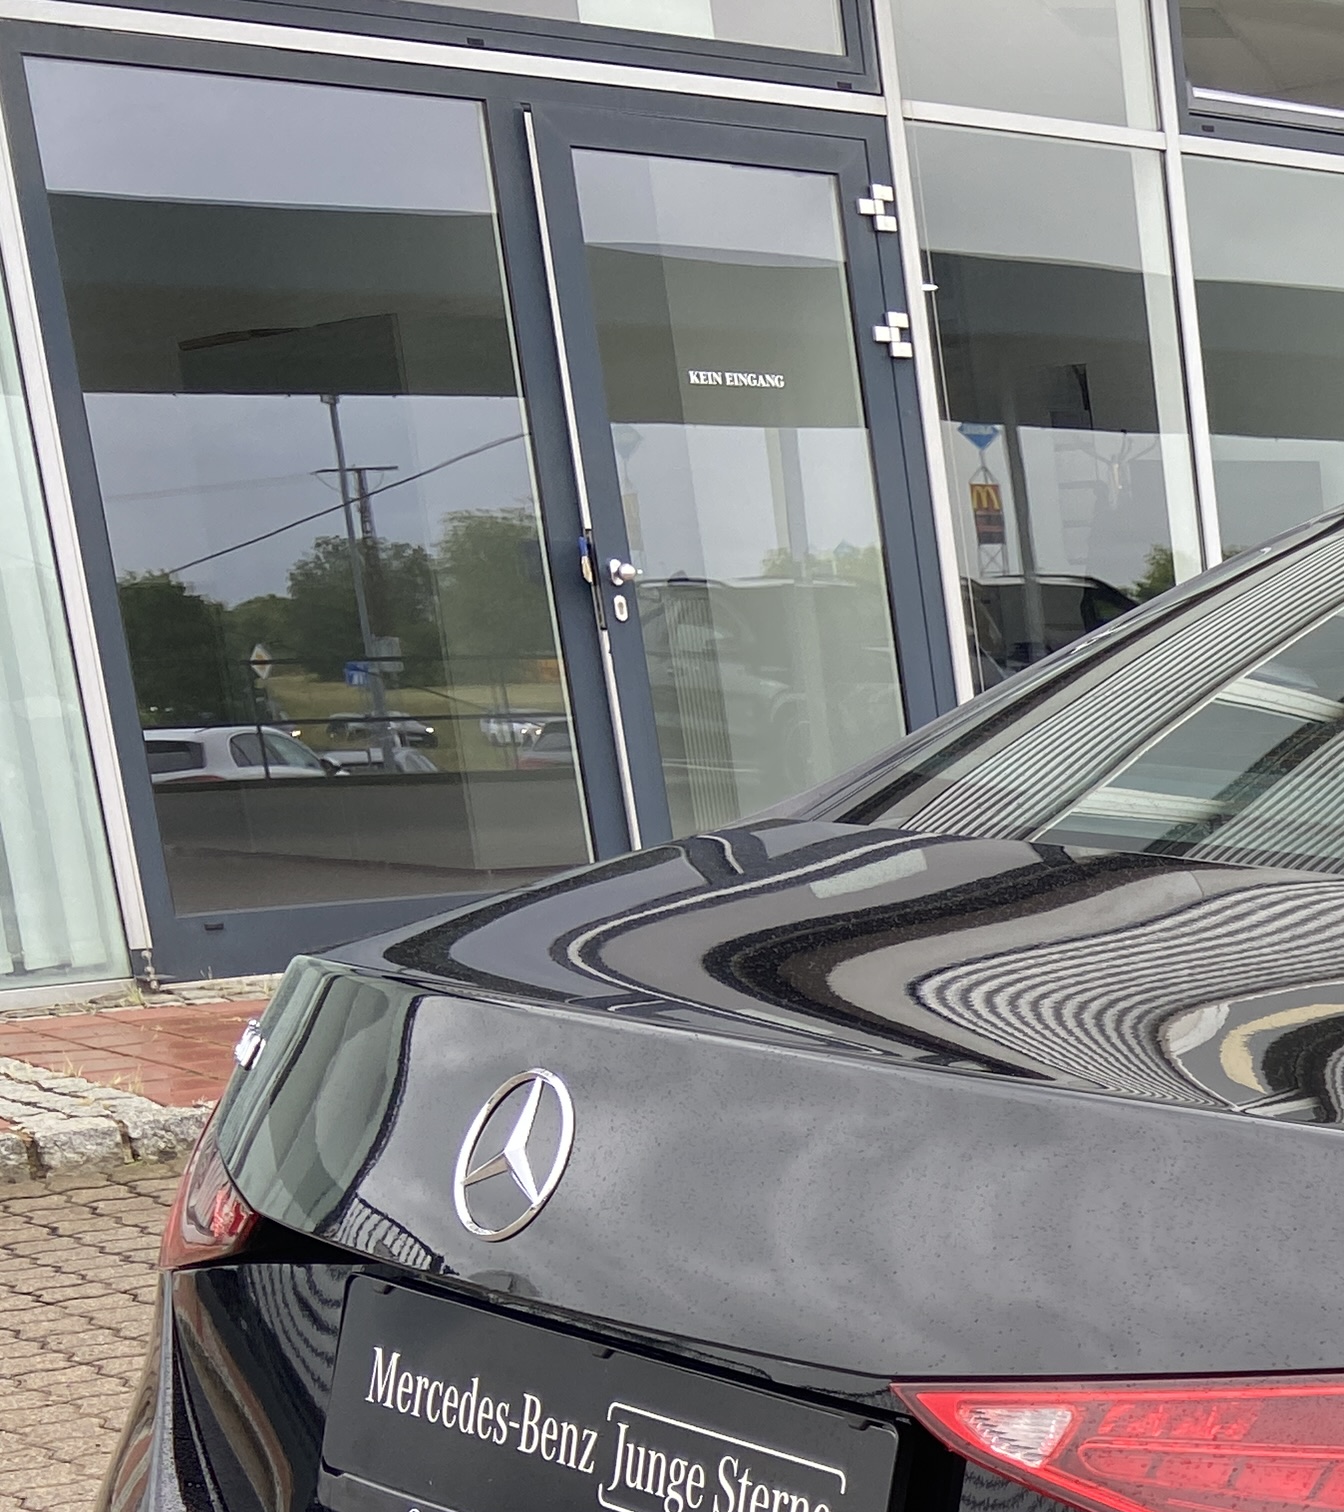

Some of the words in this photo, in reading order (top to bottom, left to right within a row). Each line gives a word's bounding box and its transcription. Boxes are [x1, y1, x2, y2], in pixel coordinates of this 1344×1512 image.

[688, 370, 722, 385] KEIN
[725, 372, 785, 388] EINGANG
[365, 1346, 598, 1474] Mercedes-Benz
